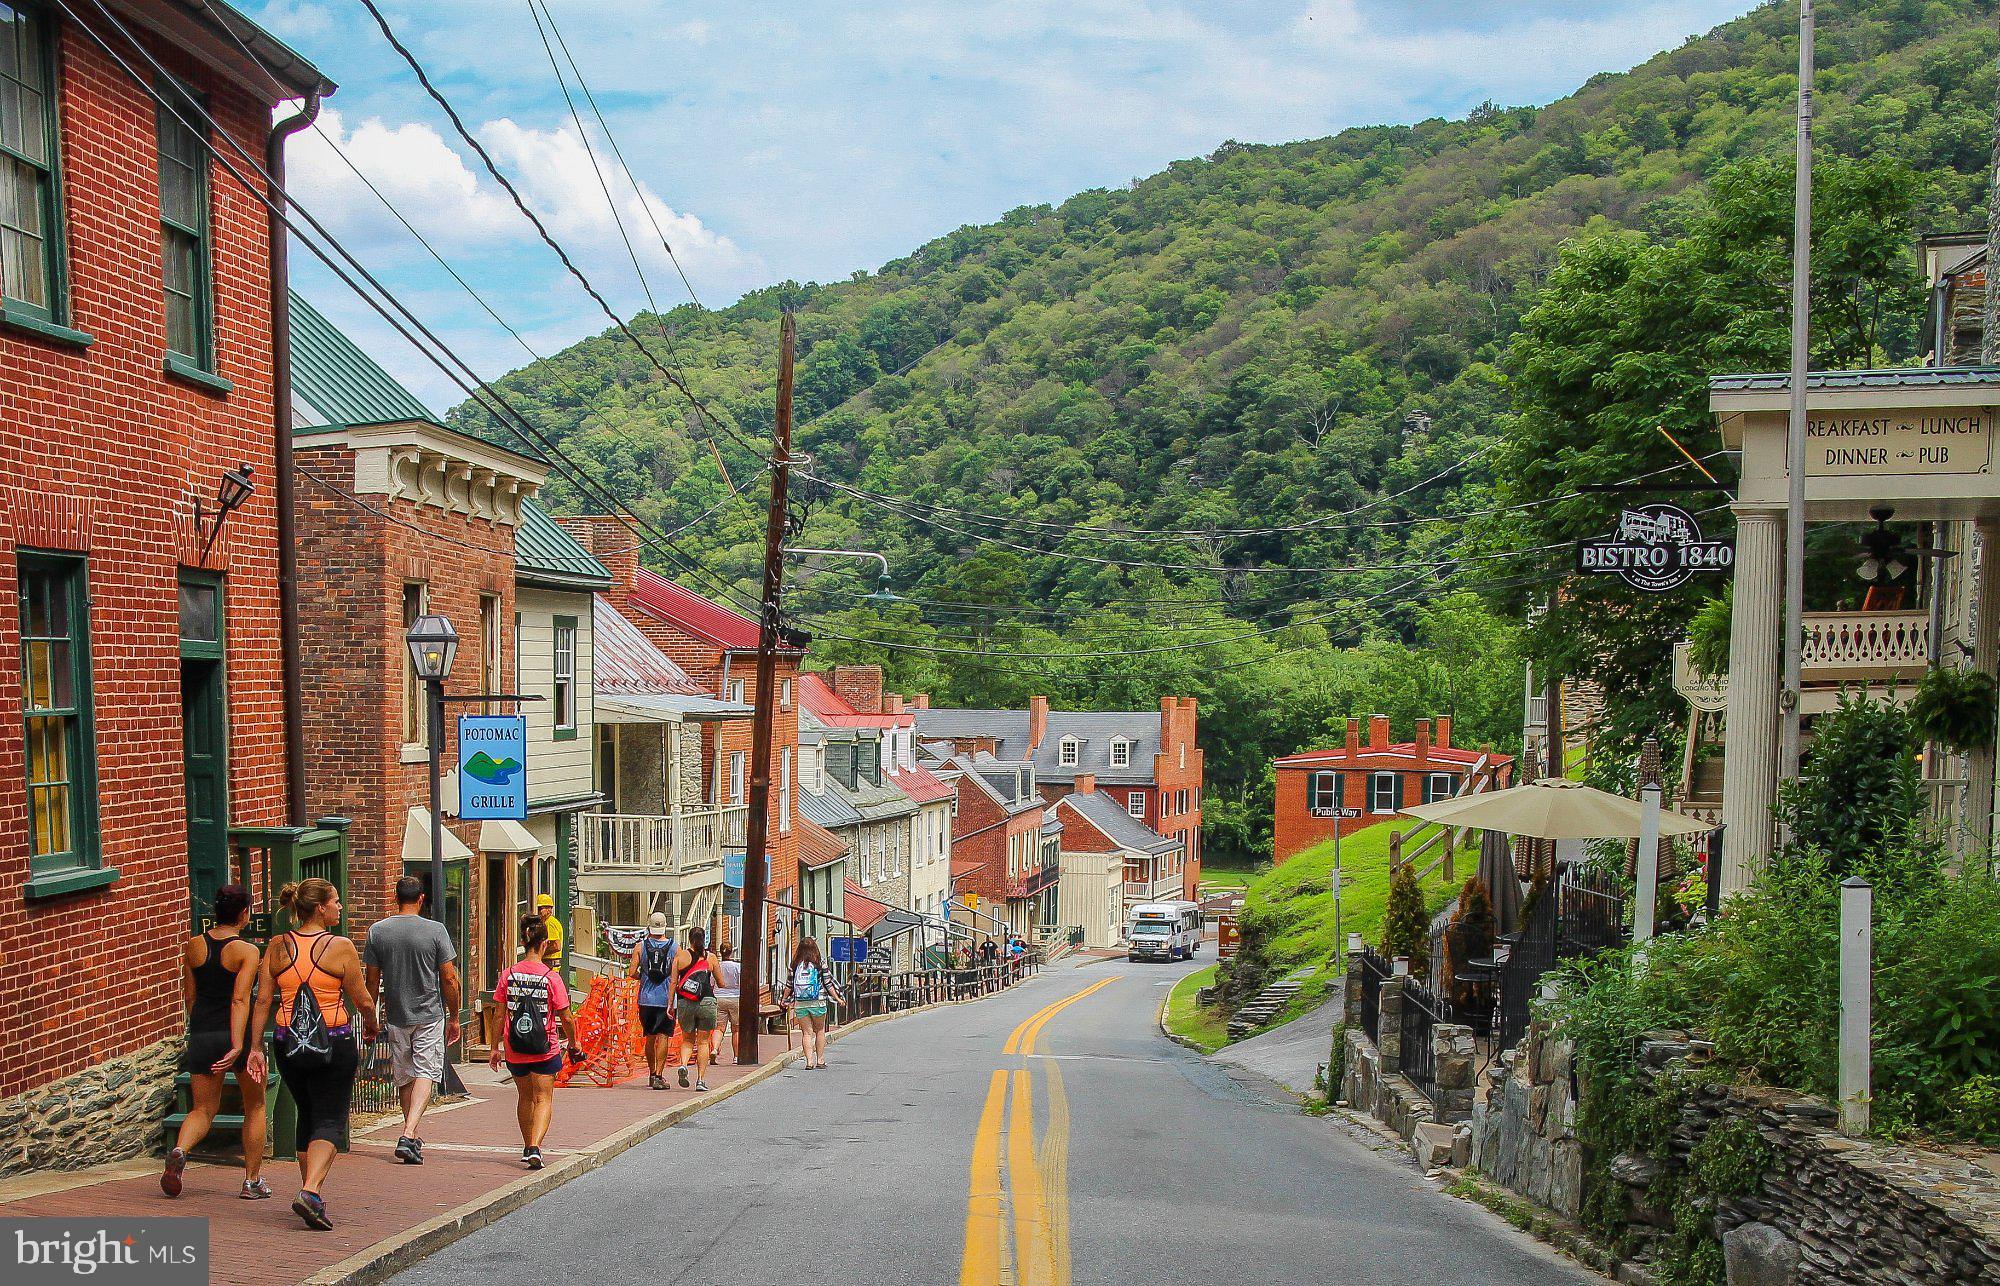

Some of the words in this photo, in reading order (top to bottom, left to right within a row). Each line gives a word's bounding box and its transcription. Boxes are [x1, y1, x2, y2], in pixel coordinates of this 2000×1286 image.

[1807, 419, 1890, 437] REAKFAST
[1920, 416, 1980, 435] LUNCH
[1825, 448, 1888, 466] DINNER
[1919, 446, 1949, 464] PUB
[1582, 547, 1669, 567] BISTRO
[1677, 546, 1734, 566] 1840
[464, 728, 519, 741] POTOMAC
[471, 796, 515, 808] GRILLE
[1316, 808, 1339, 816] Public
[1341, 809, 1357, 818] Way
